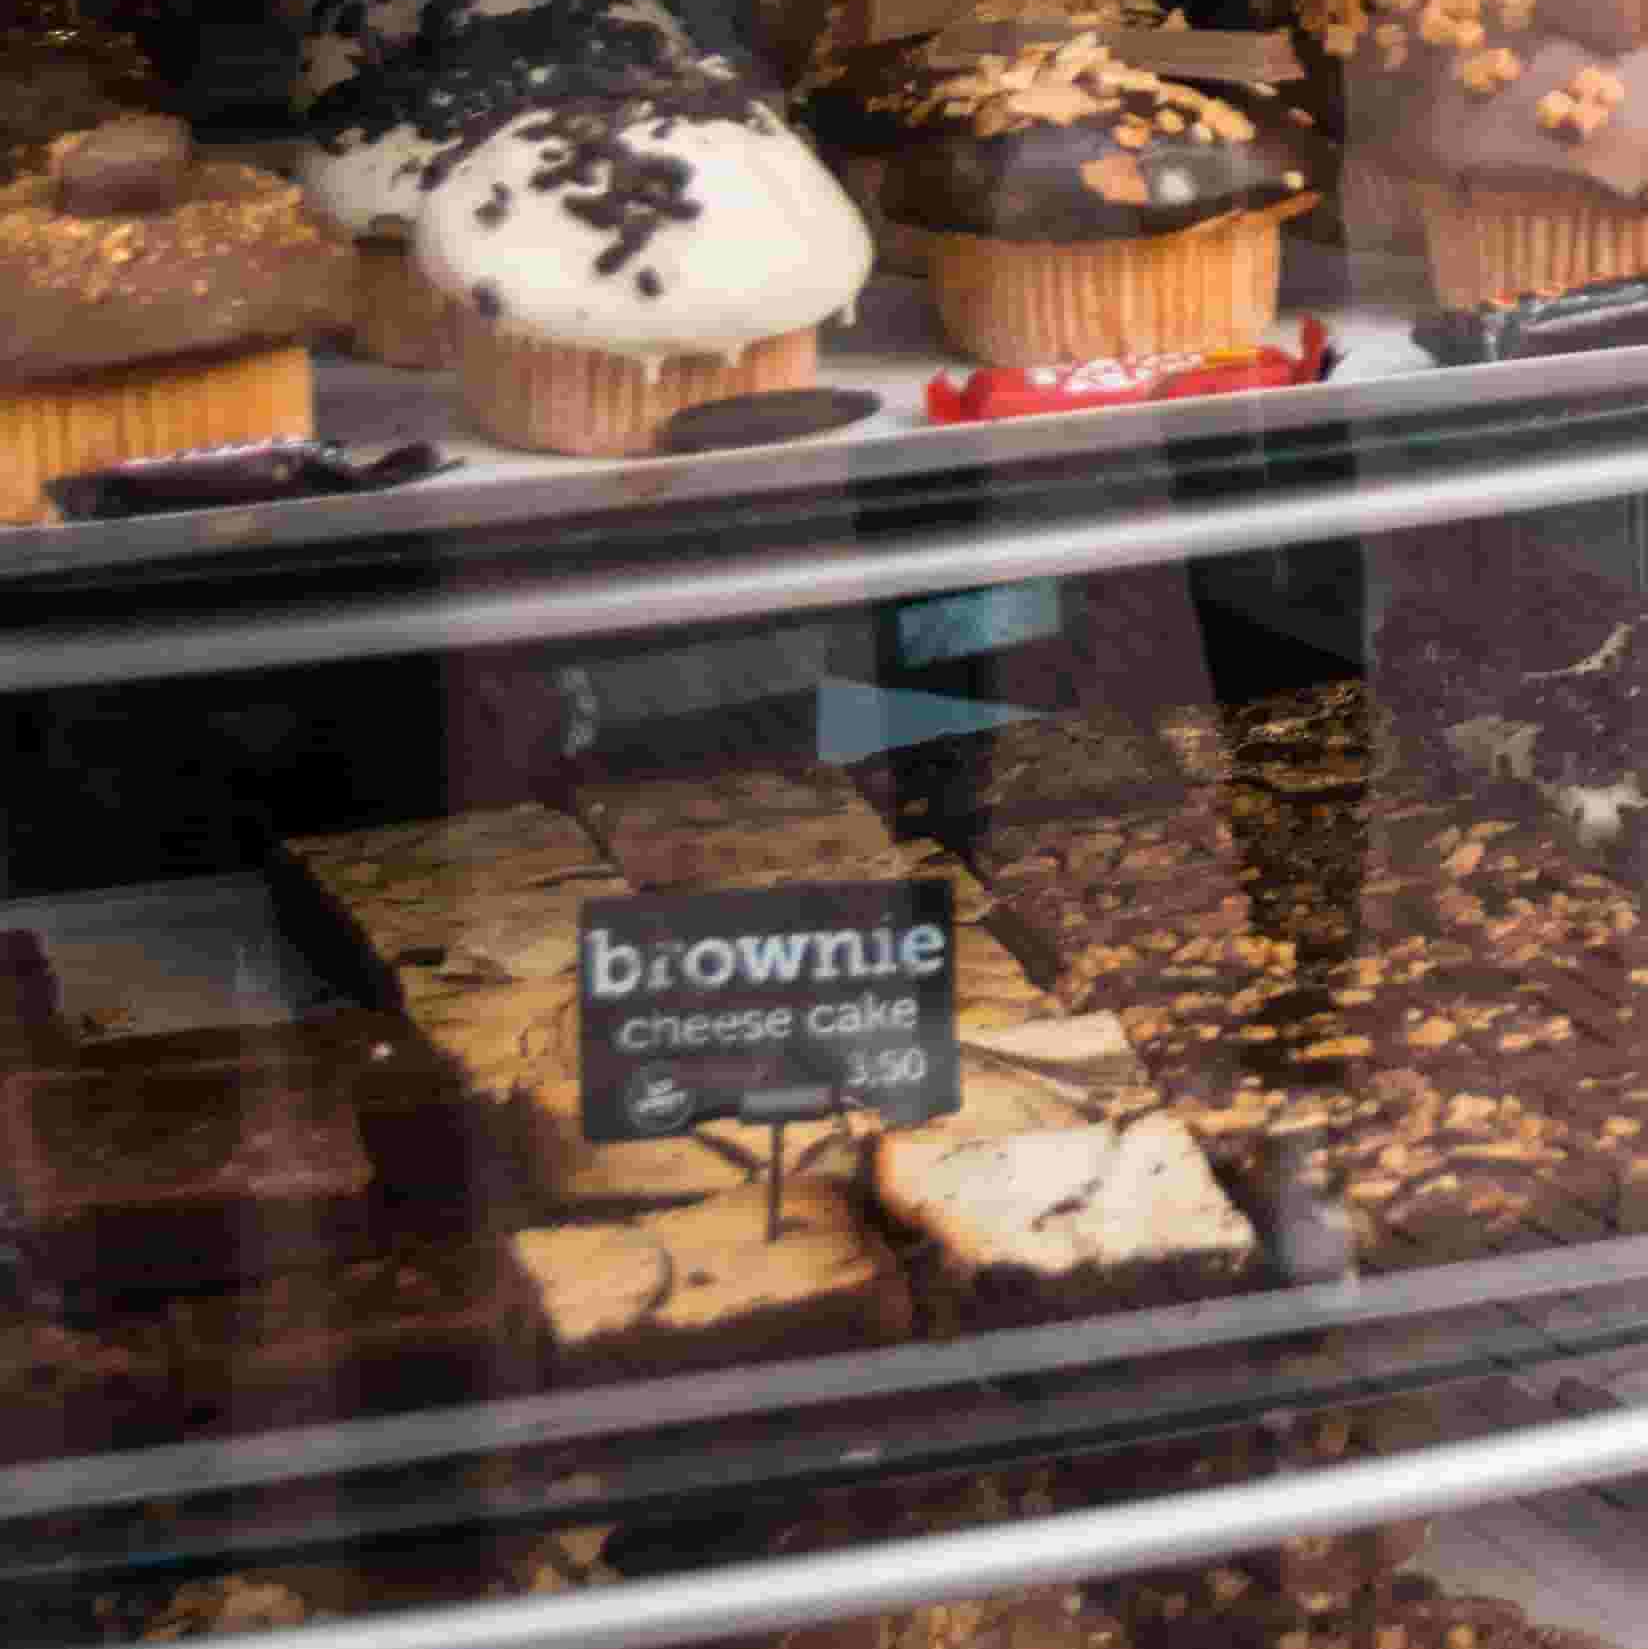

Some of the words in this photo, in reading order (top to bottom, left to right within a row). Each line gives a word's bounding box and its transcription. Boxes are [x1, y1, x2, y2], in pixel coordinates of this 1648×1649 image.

[586, 914, 946, 998] brownie
[617, 1007, 792, 1049] cheese
[806, 992, 919, 1036] cake
